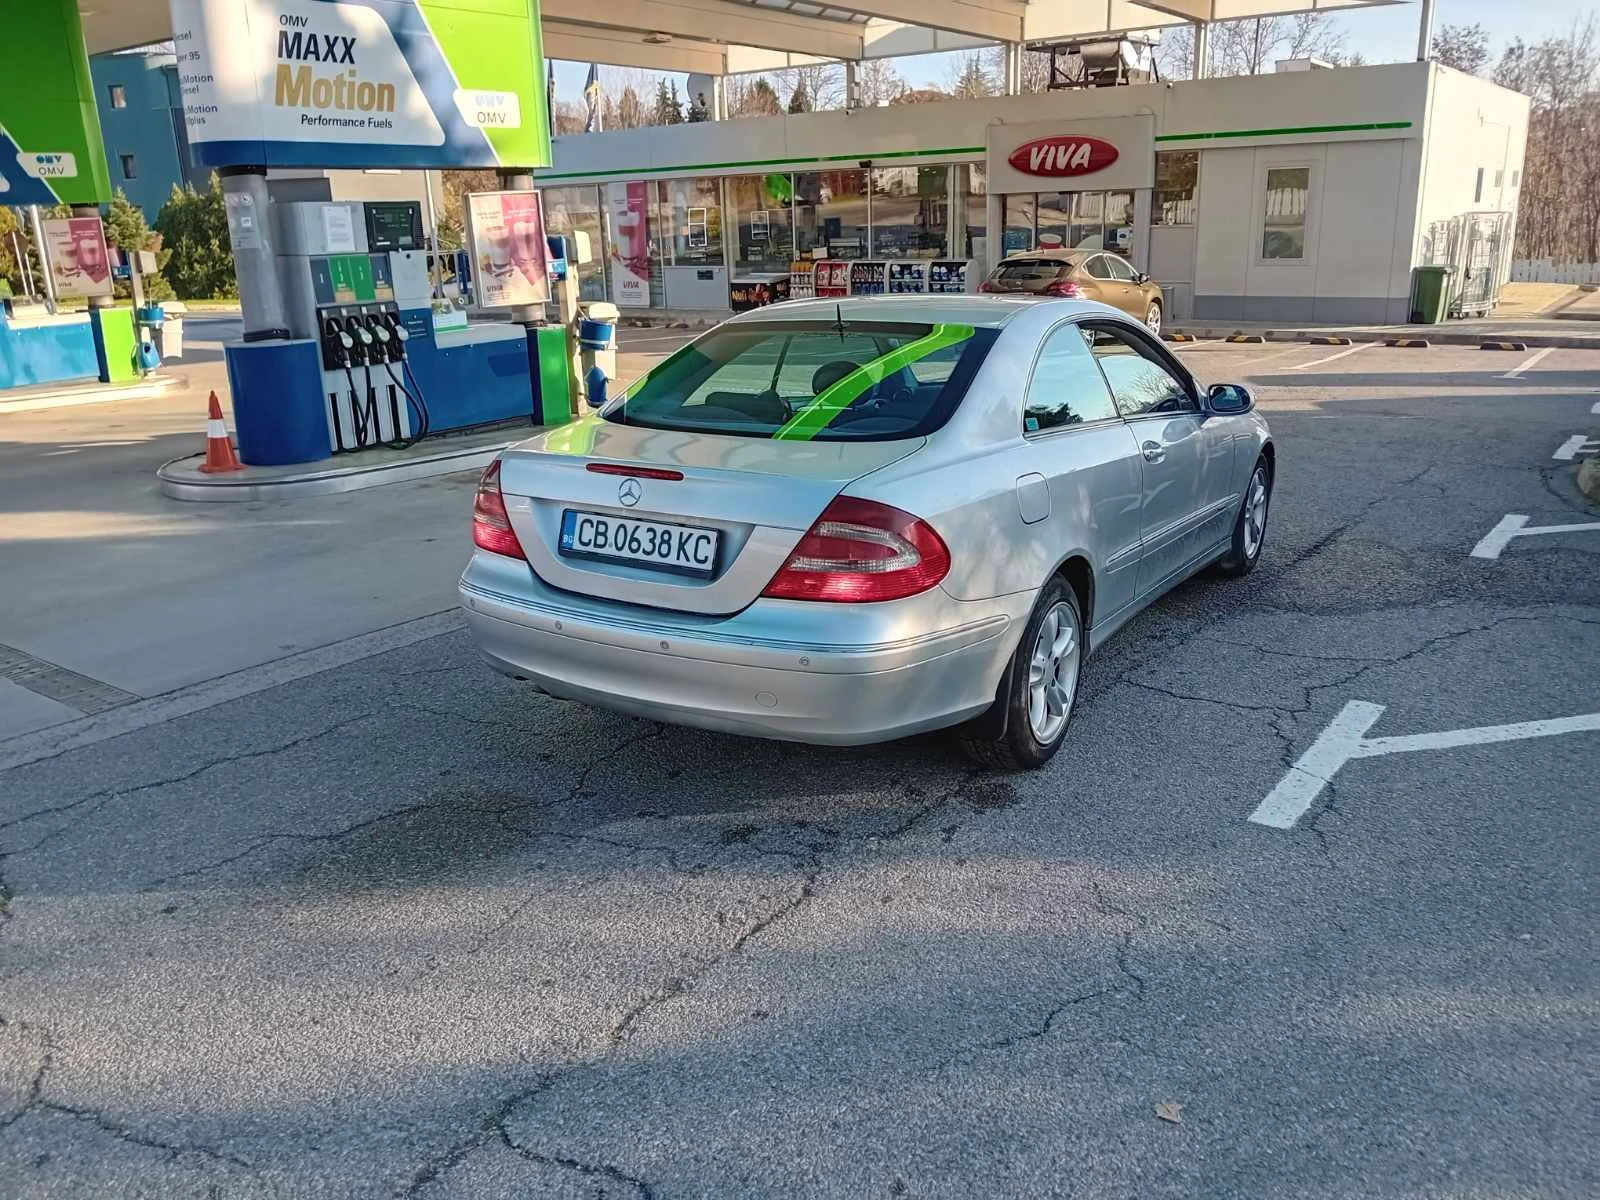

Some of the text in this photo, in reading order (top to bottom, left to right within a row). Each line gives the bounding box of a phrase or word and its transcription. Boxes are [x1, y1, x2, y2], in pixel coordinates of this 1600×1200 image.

[279, 14, 308, 28] OMV
[277, 30, 356, 65] MAXX
[275, 63, 396, 113] Motion
[300, 113, 393, 129] Performance Fuels
[477, 111, 506, 124] OMV
[1029, 143, 1091, 171] VIVA
[38, 166, 65, 176] OMV
